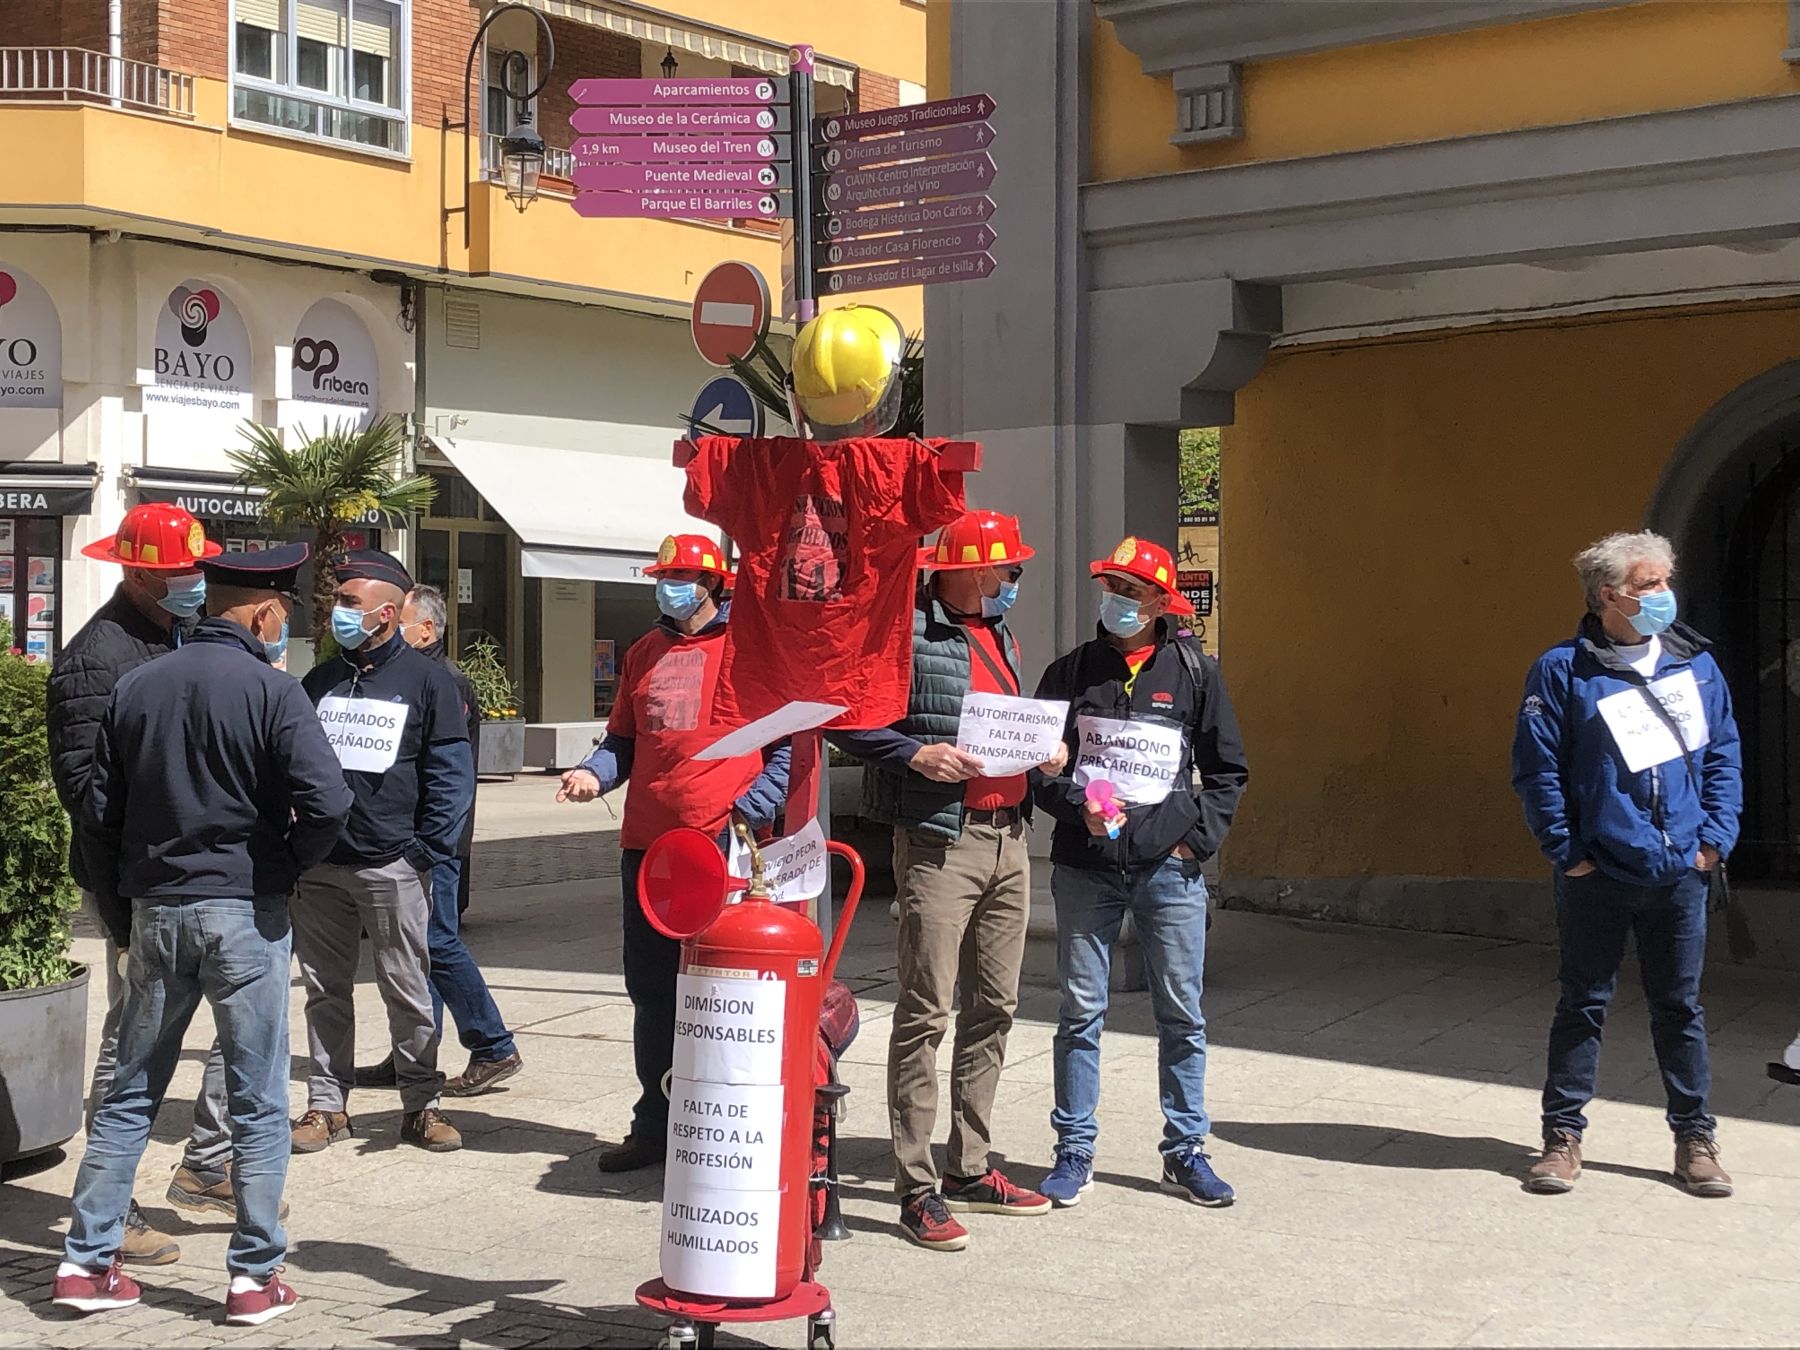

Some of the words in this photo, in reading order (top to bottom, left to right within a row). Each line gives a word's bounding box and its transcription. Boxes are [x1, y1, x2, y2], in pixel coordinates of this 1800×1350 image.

[653, 84, 750, 98] Aparcamientos
[610, 113, 653, 125] Museo
[657, 113, 672, 125] de
[677, 113, 688, 125] la
[691, 112, 751, 125] Cerámica
[845, 118, 876, 131] Museo
[877, 114, 909, 127] Juegos
[910, 102, 971, 121] Tradicionales
[582, 144, 599, 157] 1,9
[602, 143, 620, 155] km
[653, 142, 697, 154] Museo
[700, 141, 720, 154] del
[723, 141, 751, 153] Tren
[845, 147, 881, 160] Oficina
[884, 142, 897, 155] de
[900, 137, 943, 152] Turismo
[645, 169, 689, 182] Puente
[693, 169, 752, 181] Medieval
[910, 159, 975, 178] Interpretación
[846, 185, 900, 202] Arquitectura
[903, 180, 918, 193] del
[918, 178, 940, 190] Vino
[641, 198, 688, 212] Parque
[690, 197, 701, 210] El
[705, 197, 753, 210] Barriles
[846, 217, 879, 230] Bodega
[881, 211, 921, 225] Histórica
[923, 209, 942, 220] Don
[943, 205, 973, 217] Carlos
[847, 245, 884, 257] Asador
[885, 241, 910, 254] Casa
[913, 236, 961, 251] Florencio
[847, 274, 865, 286] Rte.
[867, 270, 899, 283] Asador
[901, 268, 910, 279] El
[912, 266, 936, 280] Lagar
[938, 263, 950, 275] de
[952, 260, 974, 273] Isilla
[155, 348, 234, 382] BAYO
[2, 370, 44, 380] VIAJES
[193, 382, 206, 392] DE
[209, 383, 240, 396] VIAJES
[322, 376, 369, 395] ribera
[146, 393, 240, 409] www.viajesbayo.com
[320, 710, 396, 729] QUEMADOS
[968, 706, 1059, 727] AUTORITARISMO,
[988, 728, 1020, 742] FALTA
[1023, 732, 1038, 744] DE
[1085, 732, 1171, 757] ABANDONO
[965, 744, 1051, 762] TRANSPARENCIA
[1080, 754, 1170, 780] PRECARIEDAD
[796, 840, 816, 861] PEOR
[809, 856, 821, 871] DE
[685, 995, 754, 1015] DIMISION
[684, 1099, 723, 1117] FALTA
[728, 1104, 748, 1118] DE
[674, 1122, 725, 1142] RESPETO
[729, 1130, 740, 1143] A
[746, 1131, 764, 1144] LA
[676, 1149, 753, 1169] PROFESIÓN
[671, 1202, 758, 1226] UTILIZADOS
[667, 1230, 758, 1254] HUMILLADOS
